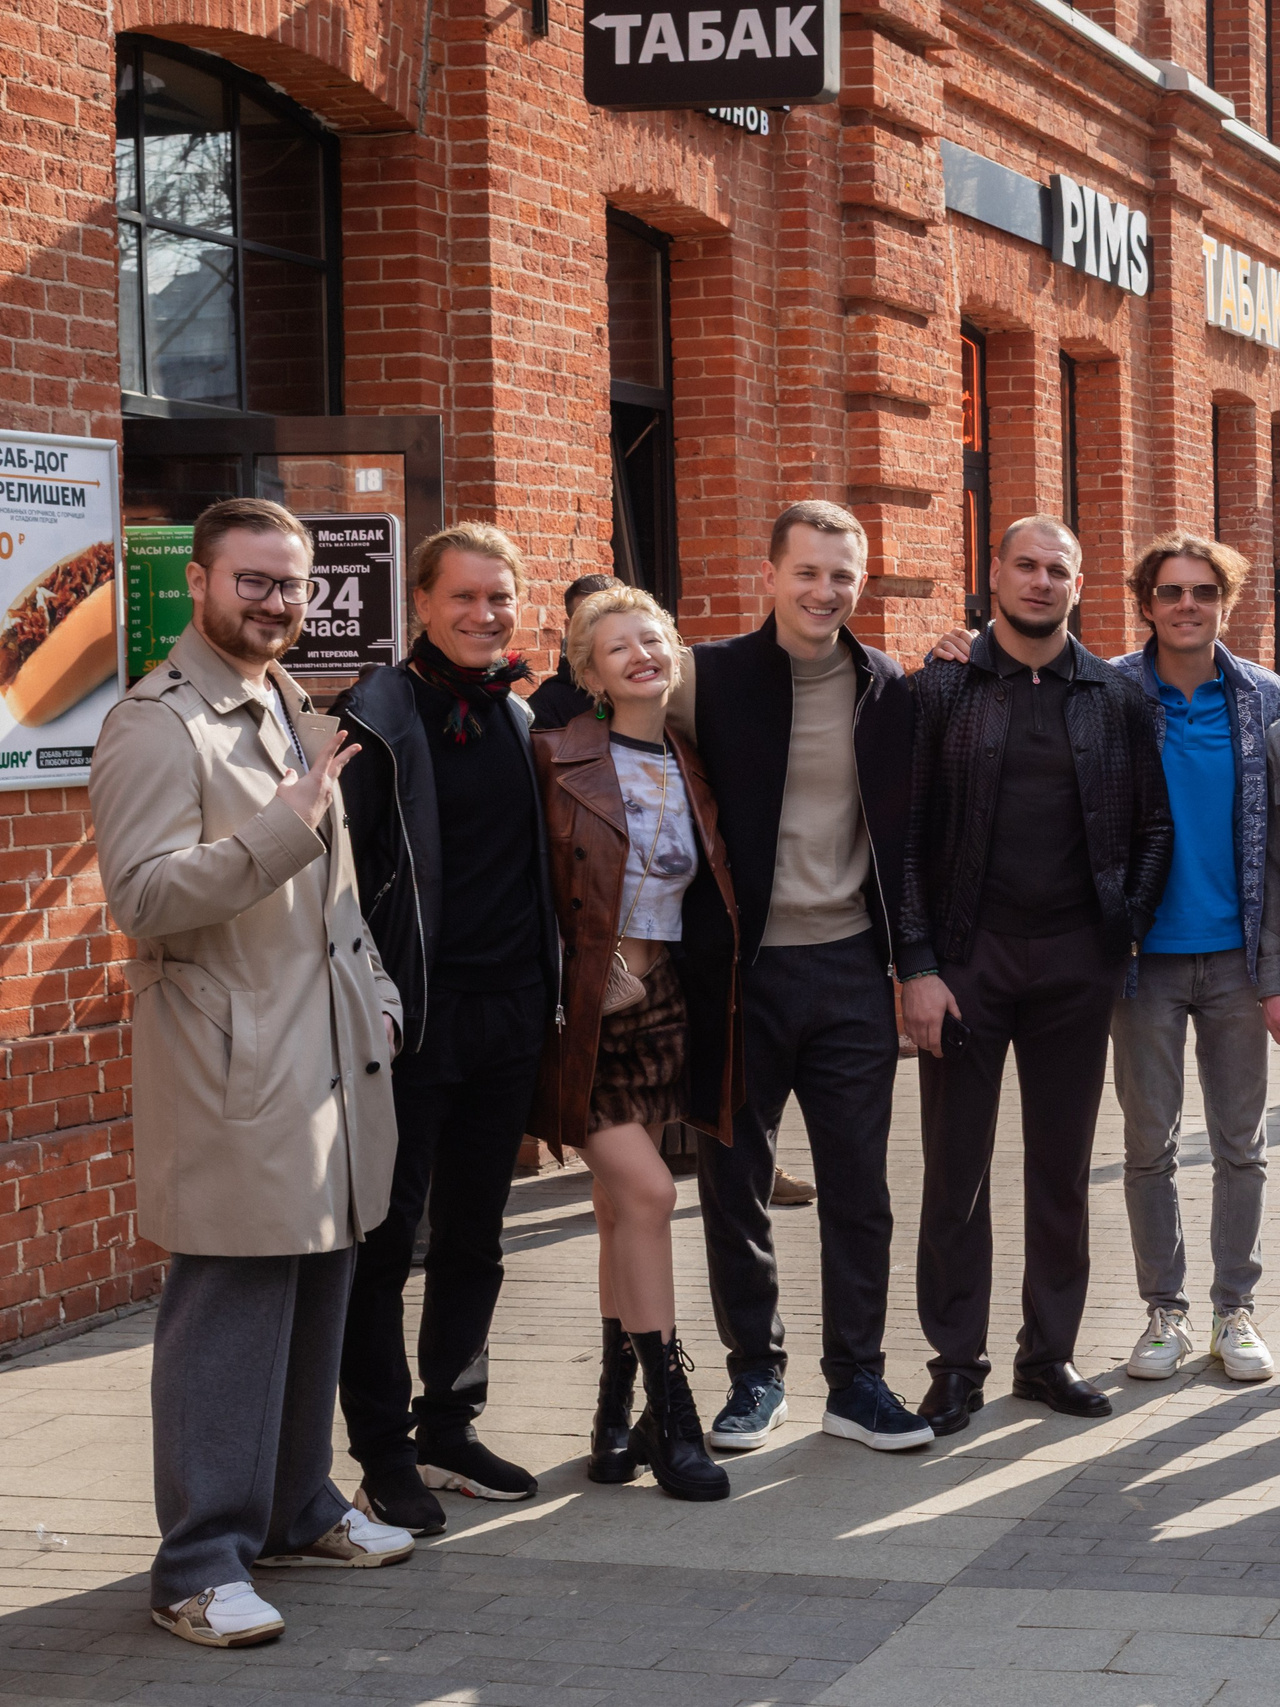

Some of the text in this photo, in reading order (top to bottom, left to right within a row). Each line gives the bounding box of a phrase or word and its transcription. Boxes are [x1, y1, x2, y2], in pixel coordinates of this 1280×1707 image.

[589, 5, 819, 65] ТАБАК
[1059, 173, 1149, 297] PIMS
[0, 447, 69, 474] АБ-ДОГ
[355, 469, 381, 492] 18
[318, 529, 385, 542] МосТАБАК
[131, 546, 162, 556] ЧАСЫ
[164, 546, 194, 555] РАБО
[331, 564, 371, 574] РАБОТЫ
[158, 590, 180, 598] 8:00
[305, 576, 364, 618] 24
[302, 619, 361, 637] часа
[320, 650, 359, 658] ТЕРЕХОВА
